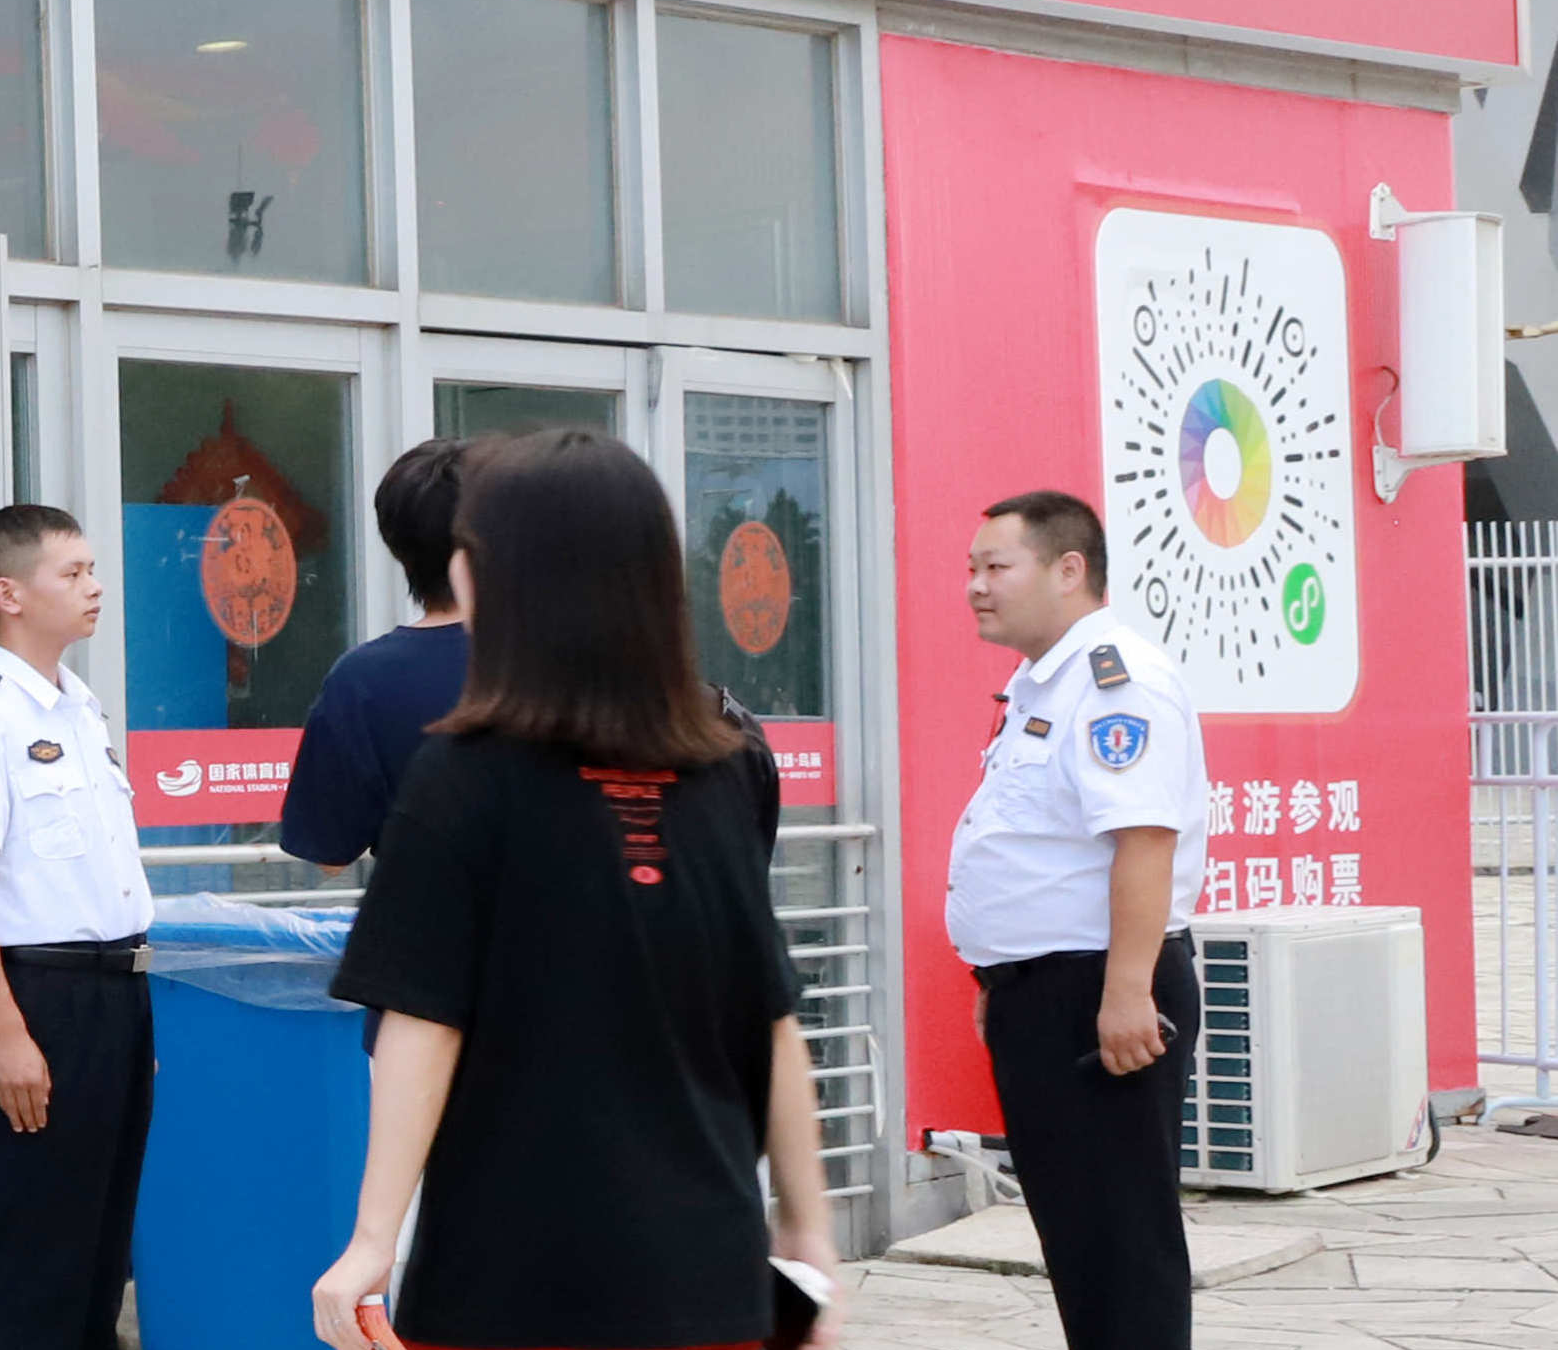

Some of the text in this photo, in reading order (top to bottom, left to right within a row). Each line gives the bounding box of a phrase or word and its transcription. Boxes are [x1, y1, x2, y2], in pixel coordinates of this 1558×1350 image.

[1207, 780, 1361, 836] 旅游参观
[1205, 853, 1363, 913] 扫码购票
